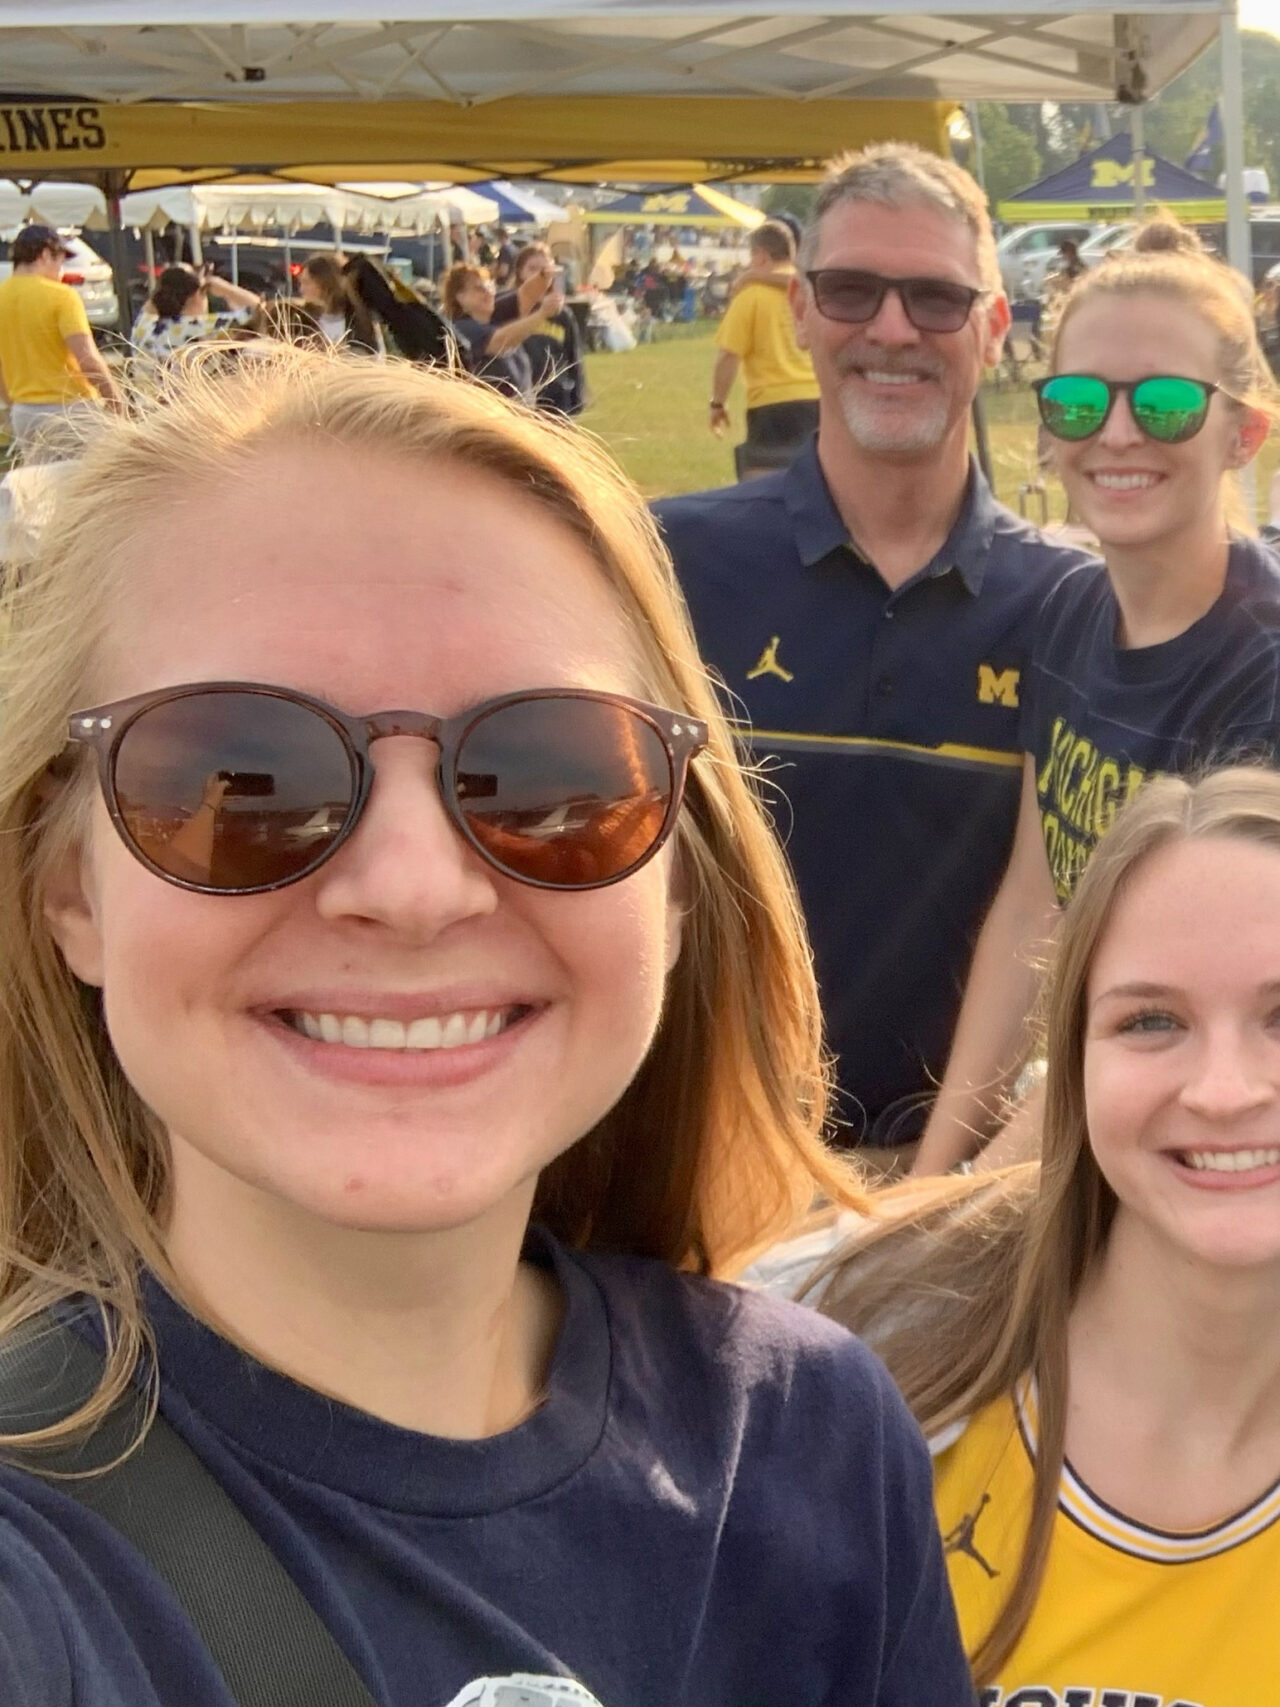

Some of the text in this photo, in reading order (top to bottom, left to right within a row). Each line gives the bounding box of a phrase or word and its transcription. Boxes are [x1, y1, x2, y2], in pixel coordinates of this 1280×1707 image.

[0, 107, 106, 152] INES
[1090, 158, 1156, 188] M
[977, 664, 1020, 708] M
